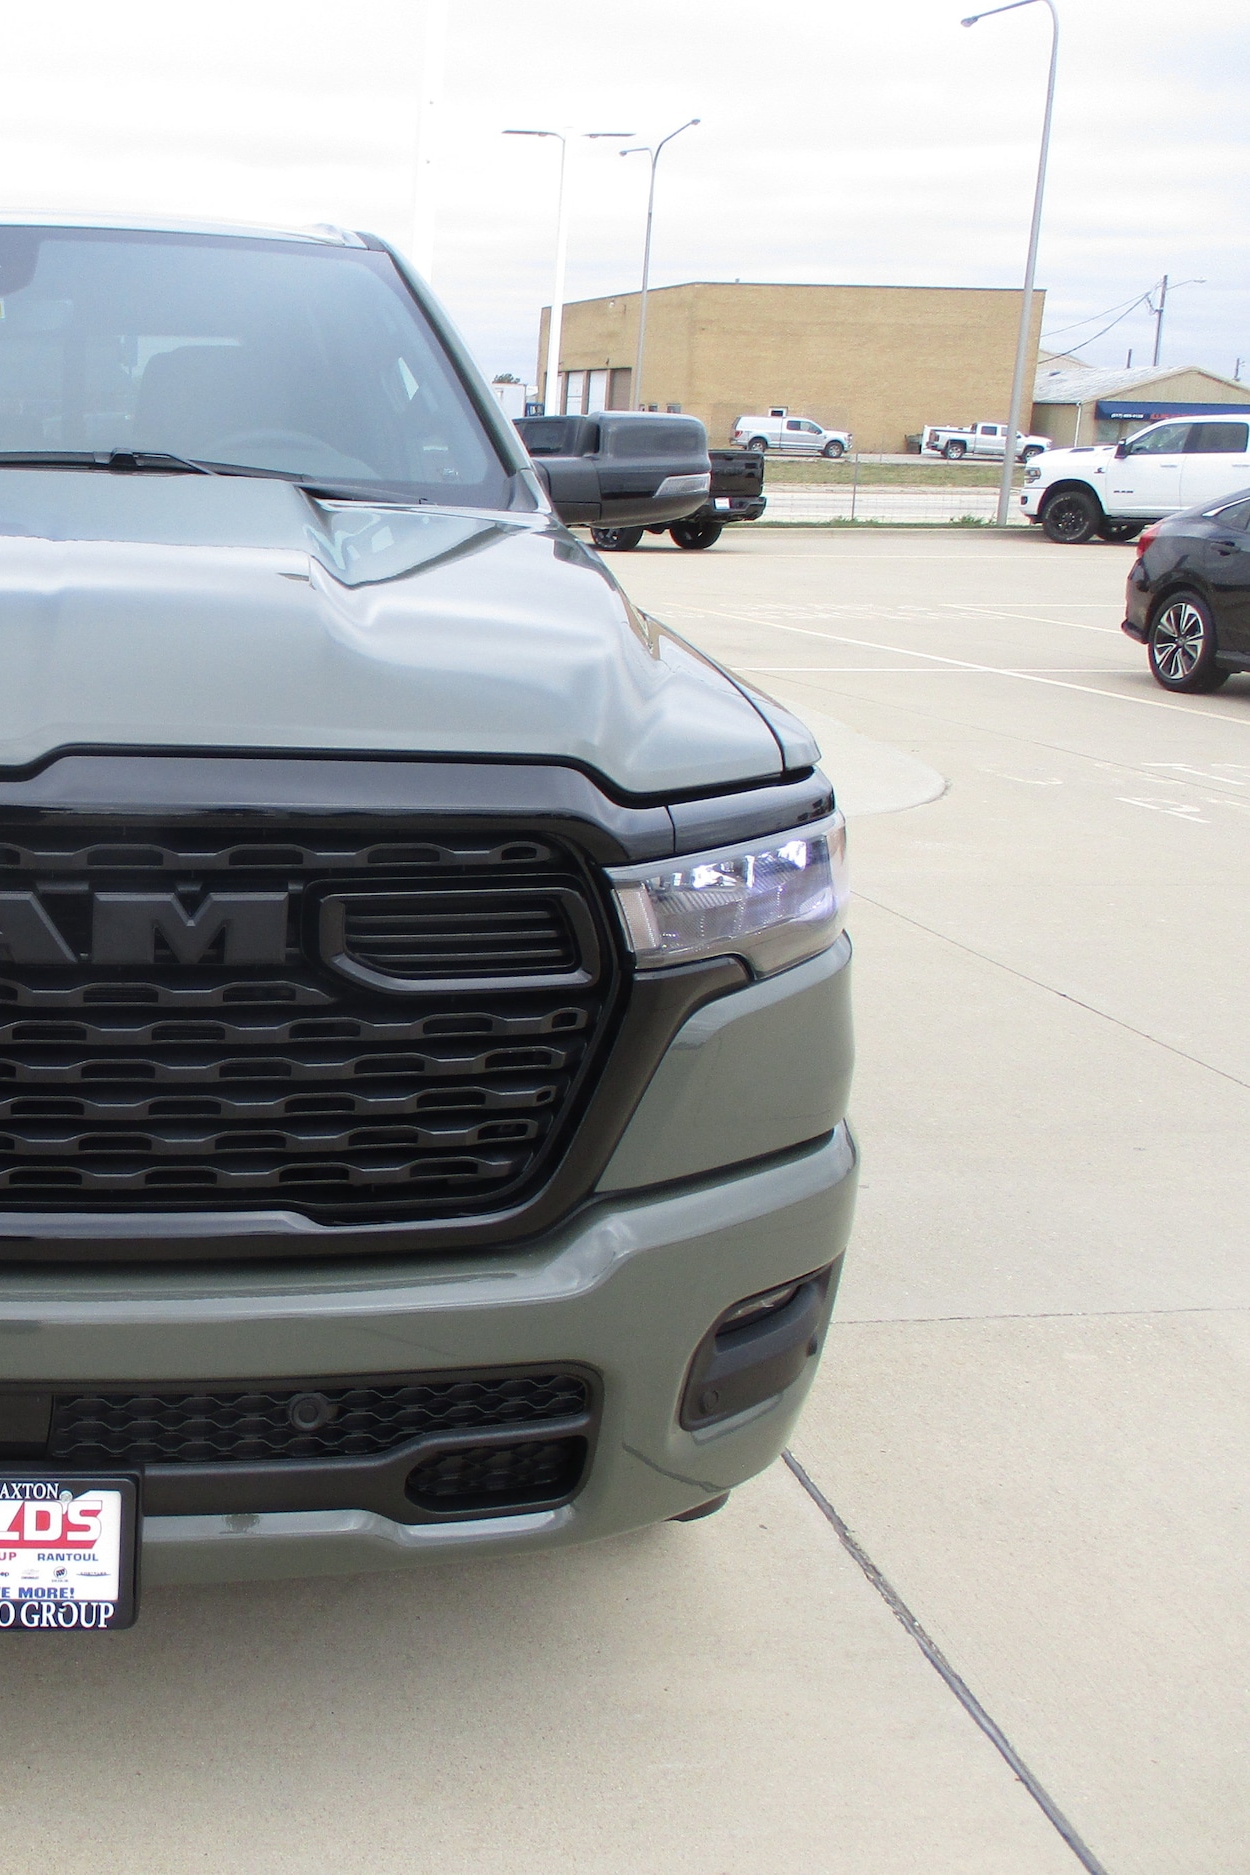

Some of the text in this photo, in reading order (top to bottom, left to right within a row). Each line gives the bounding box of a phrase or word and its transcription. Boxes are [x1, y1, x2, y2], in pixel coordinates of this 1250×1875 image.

[37, 1552, 99, 1562] RANTOUL
[18, 1586, 75, 1599] MORE!
[20, 1601, 115, 1628] GROUP
